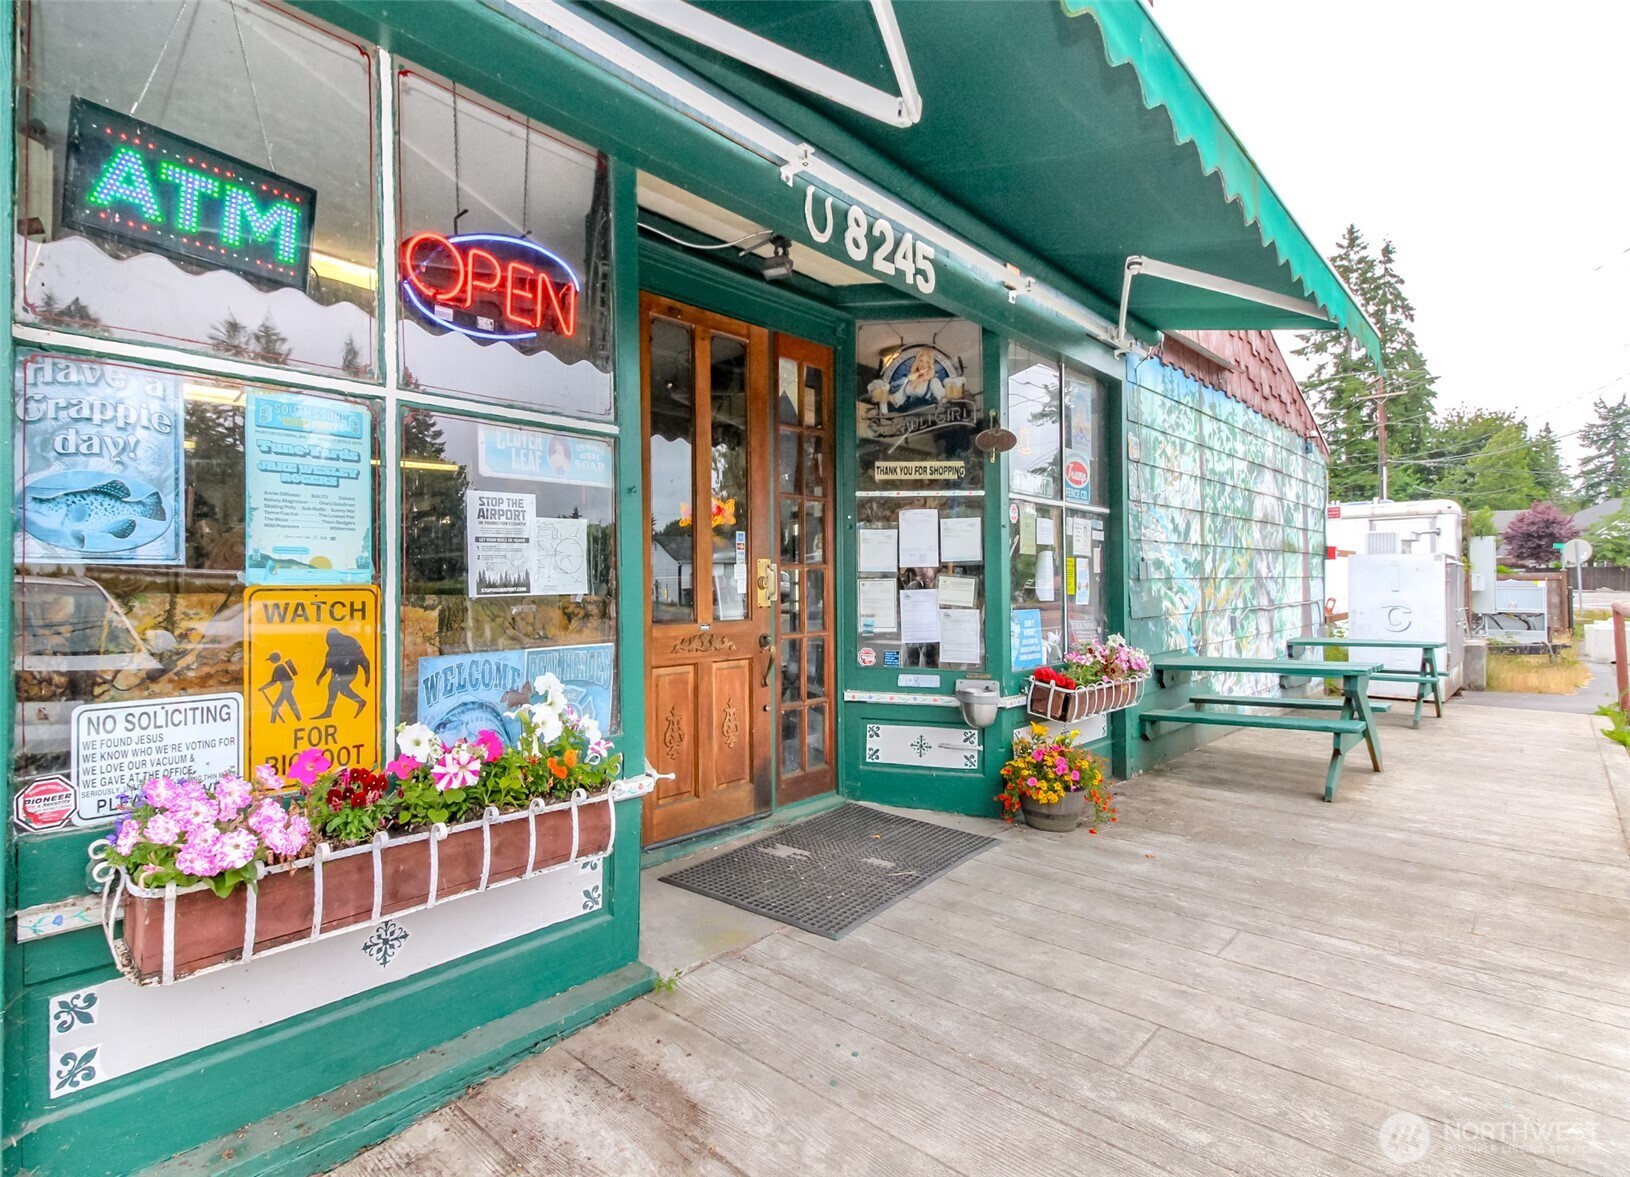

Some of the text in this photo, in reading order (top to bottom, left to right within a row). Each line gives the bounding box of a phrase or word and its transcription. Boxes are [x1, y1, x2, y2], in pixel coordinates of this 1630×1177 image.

[87, 147, 299, 264] ATM
[845, 205, 936, 294] 8245
[405, 233, 576, 337] OPEN
[26, 356, 165, 399] Have a
[15, 393, 173, 434] Crappie
[274, 403, 311, 417] SOUTH
[934, 406, 971, 425] GIRL
[53, 428, 140, 463] day!
[496, 428, 543, 451] CLOVER
[511, 447, 543, 472] LEAF
[575, 459, 605, 471] SOAP
[876, 466, 965, 477] THANK YOU FOR SHOPPING
[478, 496, 524, 508] STOP THE
[477, 508, 527, 521] AIRPORT
[262, 600, 366, 624] WATCH
[563, 650, 611, 689] HEROES
[422, 659, 521, 707] WELCOME
[87, 704, 232, 736] NO SOLICITING
[82, 733, 164, 751] WE FOUND JESUS
[293, 724, 338, 750] FOR
[82, 737, 235, 764] WE KNOW WHO WE'RE VOTING FOR
[82, 753, 195, 777] WE LOVE OUR VACUUM &
[82, 777, 97, 789] WE
[100, 774, 126, 787] GAVE
[128, 771, 141, 782] AT
[143, 768, 160, 780] THE
[24, 793, 72, 805] PIONEER
